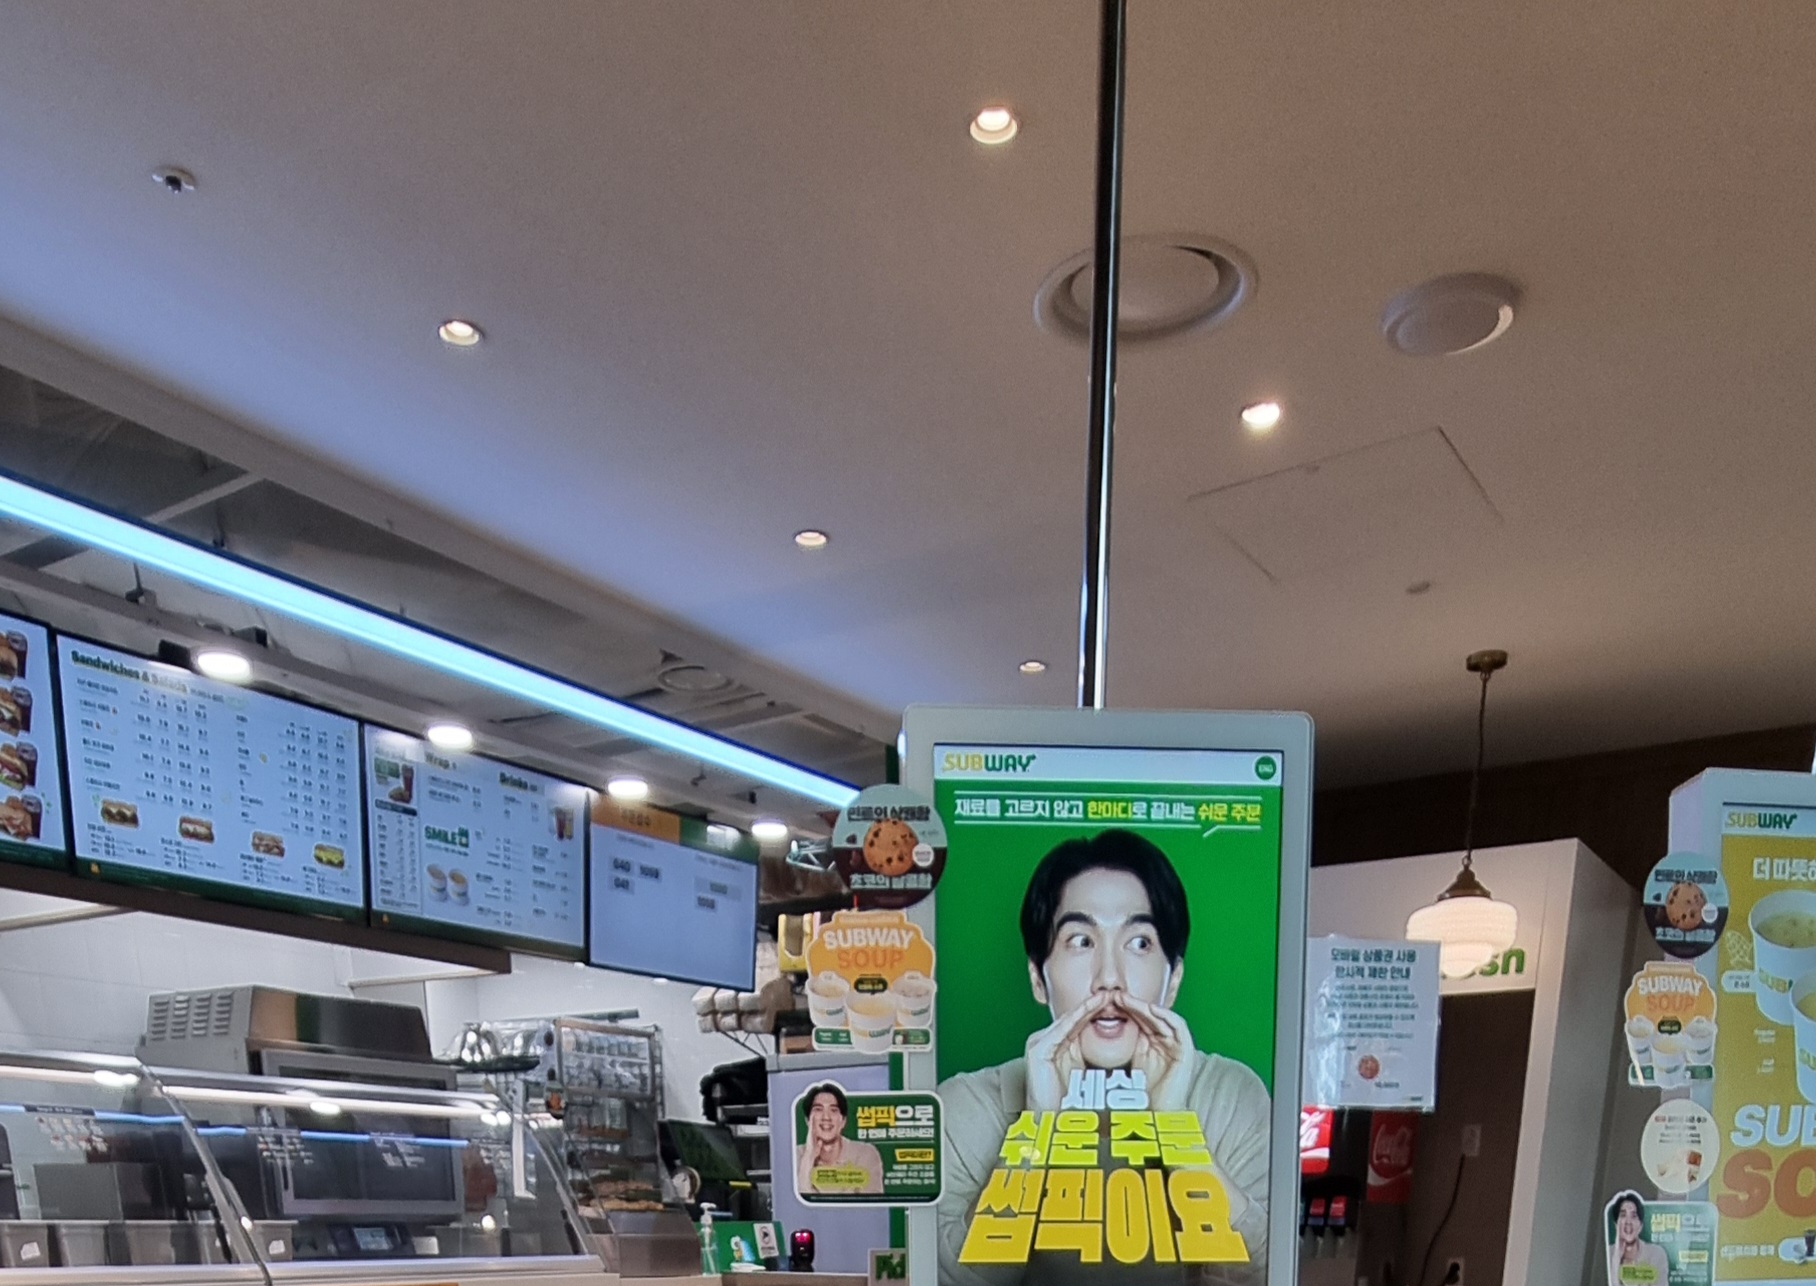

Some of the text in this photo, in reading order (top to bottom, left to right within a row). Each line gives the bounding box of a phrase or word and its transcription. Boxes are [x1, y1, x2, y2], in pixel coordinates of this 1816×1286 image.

[943, 753, 1037, 773] SUBWAY
[954, 799, 1261, 823] 재료를 고르지 않고 한마디로 끝내는 쉬운 주문
[1725, 812, 1798, 829] SUBWAY
[1753, 857, 1770, 879] 더
[823, 927, 914, 950] SUBWAY
[838, 950, 903, 969] SOUP
[1637, 976, 1702, 996] SUBWAY
[1647, 995, 1694, 1012] SOUP
[1061, 1069, 1149, 1110] 세상
[857, 1104, 934, 1127] 썹픽으로
[999, 1110, 1213, 1166] 쉬운 주문
[1716, 1149, 1816, 1219] SO
[958, 1168, 1250, 1264] 썹픽이요
